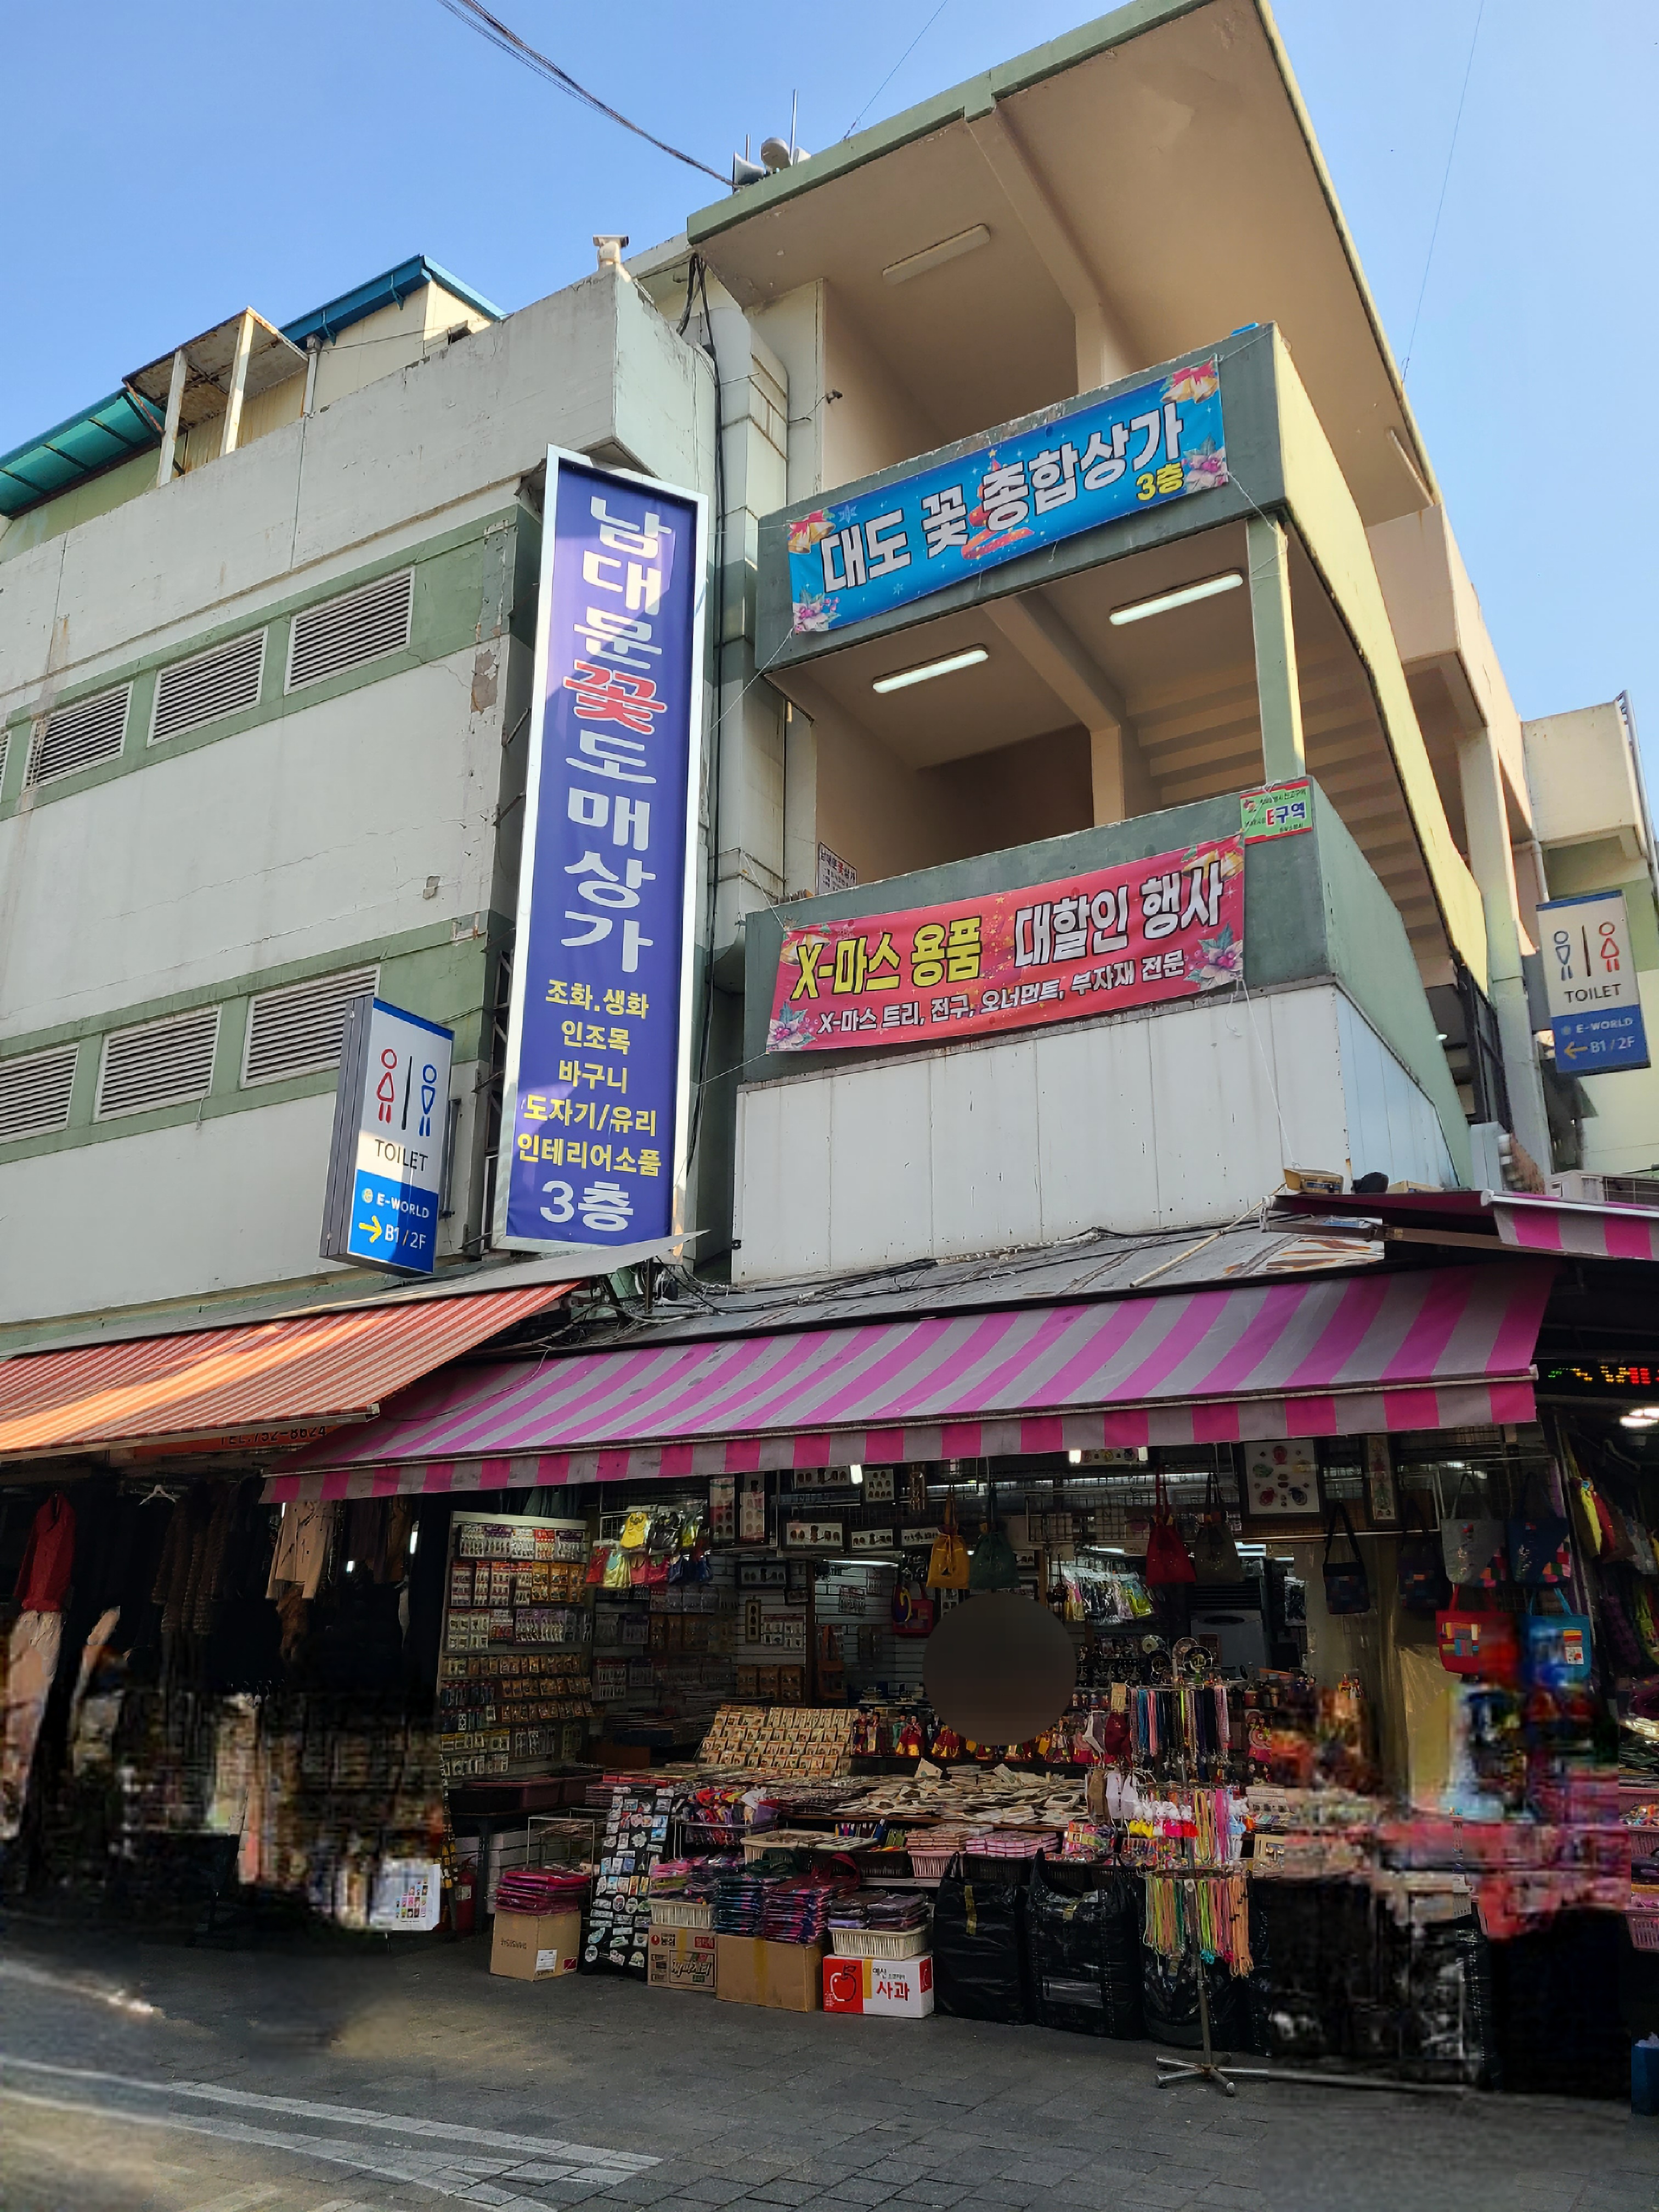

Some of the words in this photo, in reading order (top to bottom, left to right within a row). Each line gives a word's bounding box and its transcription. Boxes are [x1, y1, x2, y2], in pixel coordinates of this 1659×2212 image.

[821, 508, 911, 593] 대도
[921, 484, 969, 559] 꽃
[982, 403, 1183, 532] 종합상가
[1136, 463, 1184, 503] 3층
[1266, 801, 1306, 826] E구역
[789, 932, 901, 999] X-마스
[911, 917, 981, 987] 용품
[1014, 885, 1129, 968] 대할인
[1140, 860, 1224, 940] 행사
[545, 979, 649, 1019] 조화.생화
[817, 1007, 877, 1034] X-마스
[882, 1000, 926, 1031] 트리,
[931, 994, 974, 1023] 전구,
[980, 979, 1064, 1013] 오너먼트,
[1071, 959, 1136, 996] 부자재
[1142, 949, 1186, 983] 전문
[1564, 983, 1622, 1003] TOILET
[561, 1020, 630, 1054] 인조목
[1576, 1017, 1633, 1033] E-WORLD
[559, 1060, 628, 1093] 바구니
[523, 1094, 657, 1137] 도자기/유리
[375, 1139, 428, 1171] TOILET
[517, 1133, 662, 1177] 인테리어소품
[376, 1193, 430, 1218] E-WORLD
[540, 1181, 634, 1232] 3층
[876, 1981, 910, 2001] 사과
